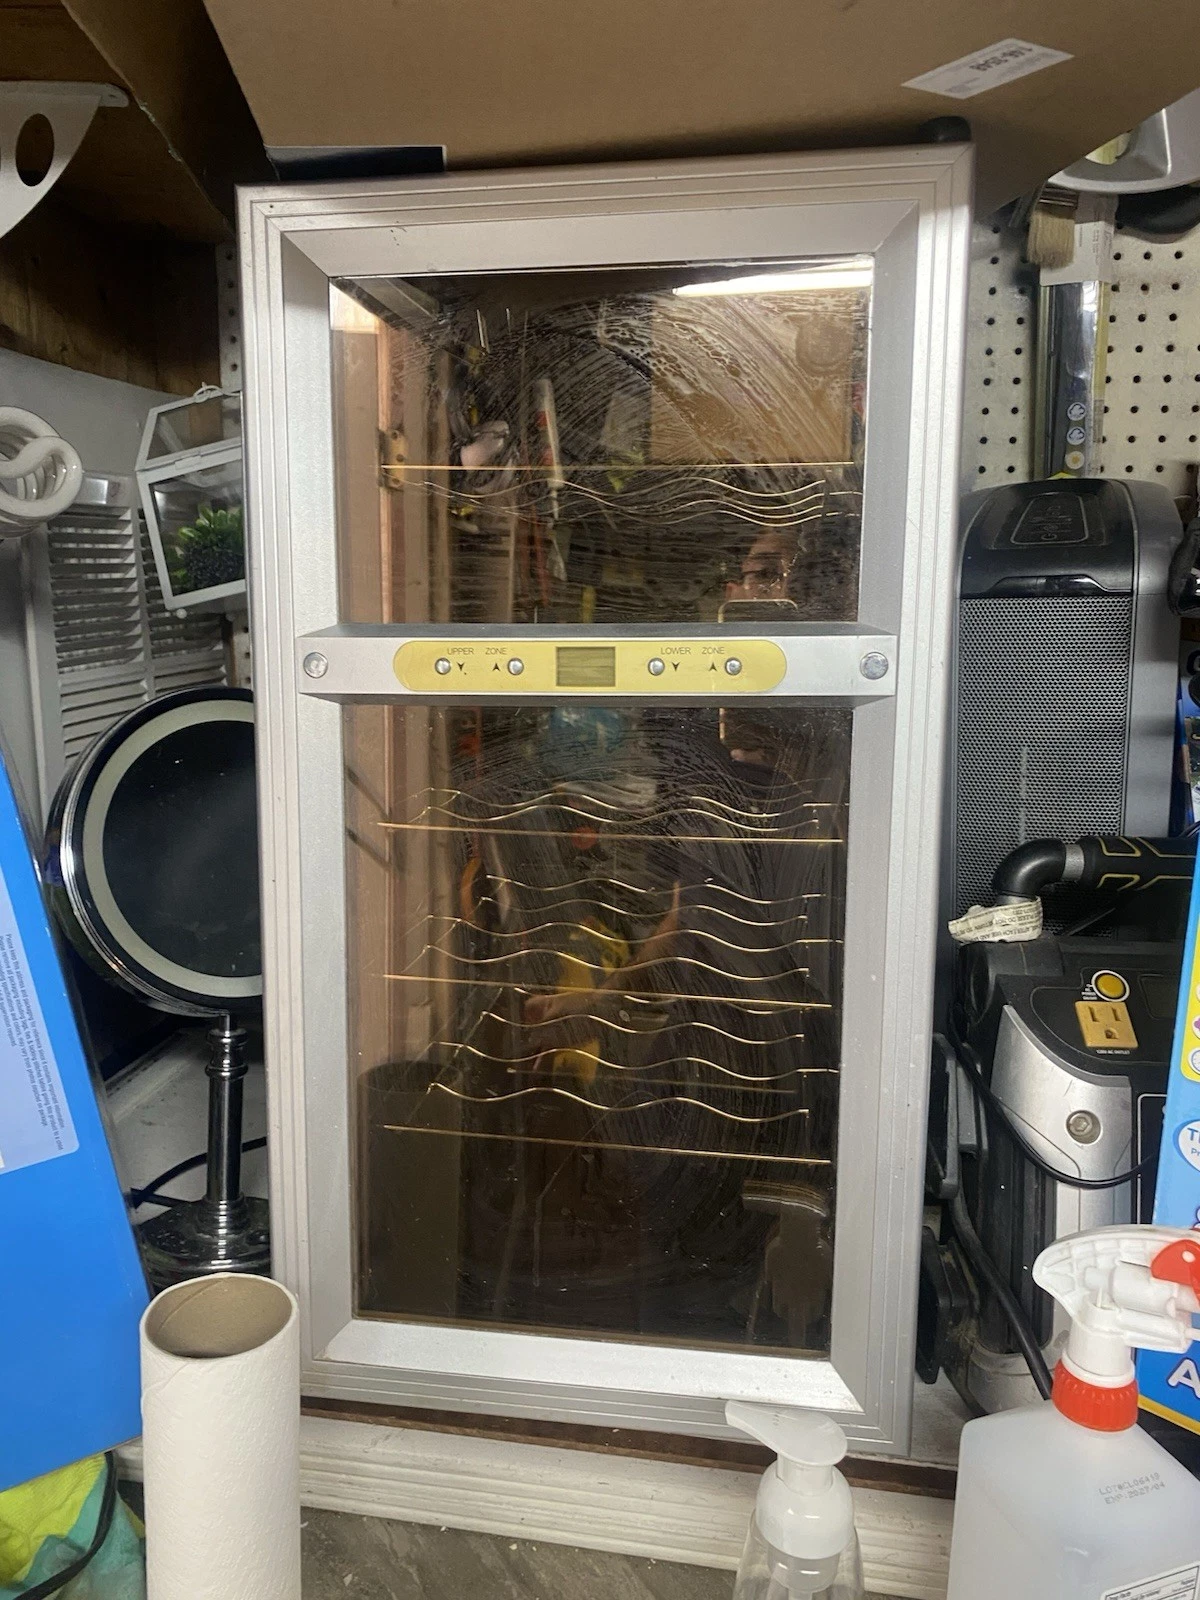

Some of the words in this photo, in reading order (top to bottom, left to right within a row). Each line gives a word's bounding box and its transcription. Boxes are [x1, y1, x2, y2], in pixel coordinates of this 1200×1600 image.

[447, 647, 474, 656] UPPER
[485, 647, 507, 655] ZONE
[660, 646, 691, 655] LOWER
[701, 646, 725, 655] ZONE
